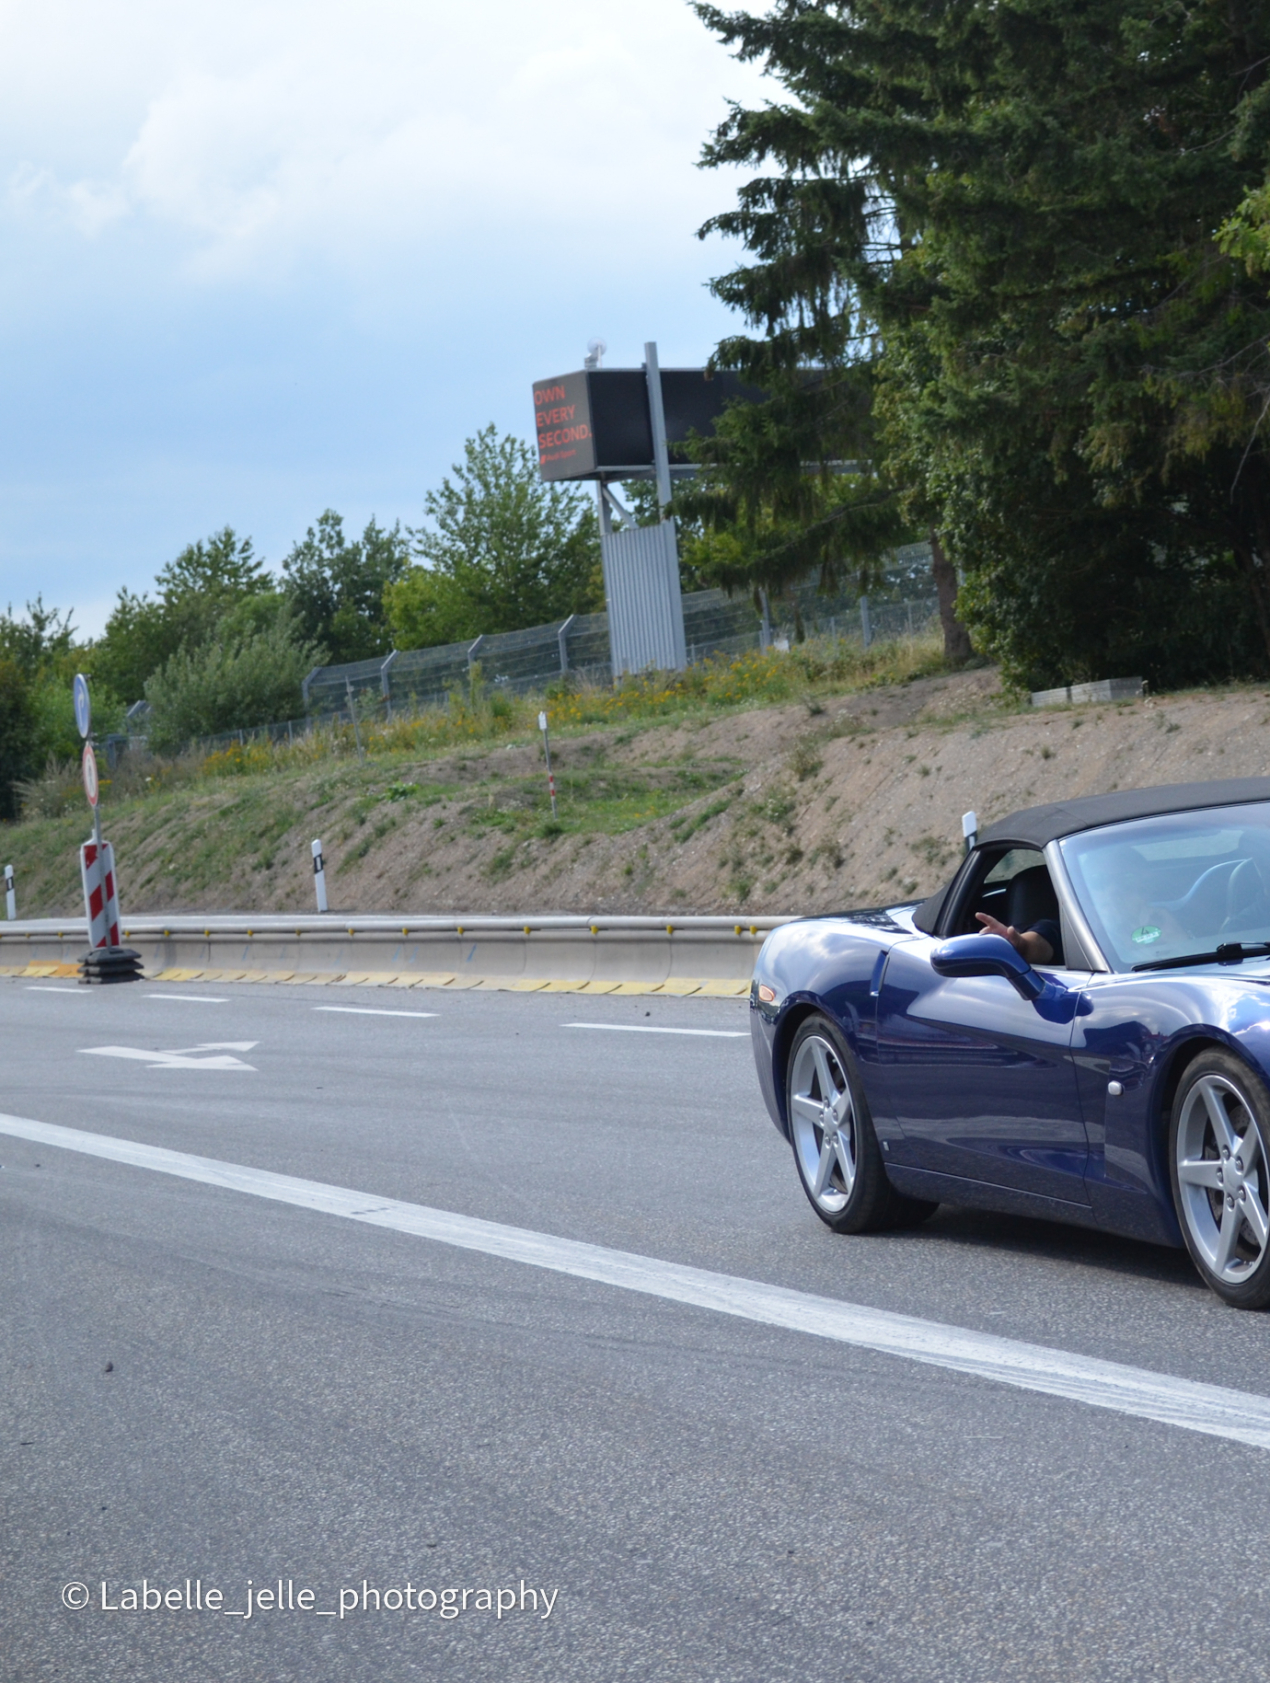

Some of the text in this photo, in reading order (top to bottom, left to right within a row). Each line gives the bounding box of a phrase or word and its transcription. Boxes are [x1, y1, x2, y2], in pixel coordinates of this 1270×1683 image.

[534, 385, 566, 406] OWN
[536, 404, 576, 427] EVERY
[538, 424, 593, 449] SECOND.
